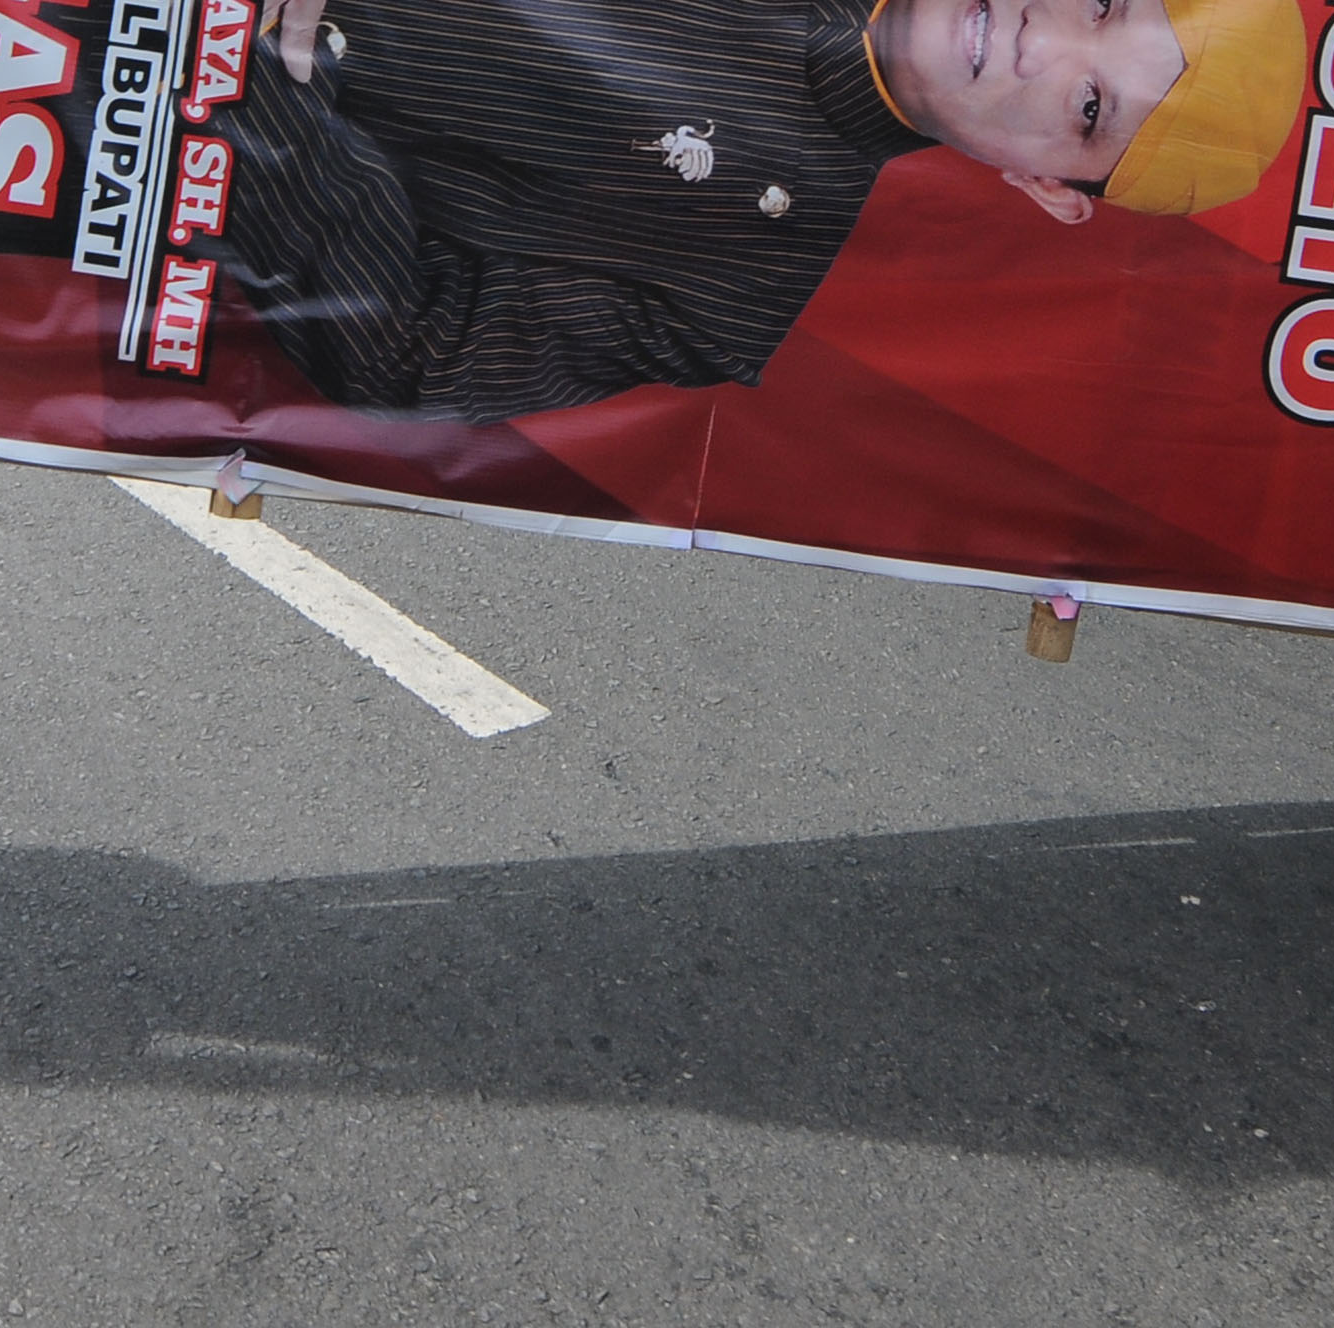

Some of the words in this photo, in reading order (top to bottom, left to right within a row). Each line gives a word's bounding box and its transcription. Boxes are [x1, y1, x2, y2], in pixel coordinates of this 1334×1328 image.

[80, 55, 151, 269] BUPATI
[171, 136, 233, 245] SH.
[149, 258, 215, 375] MH
